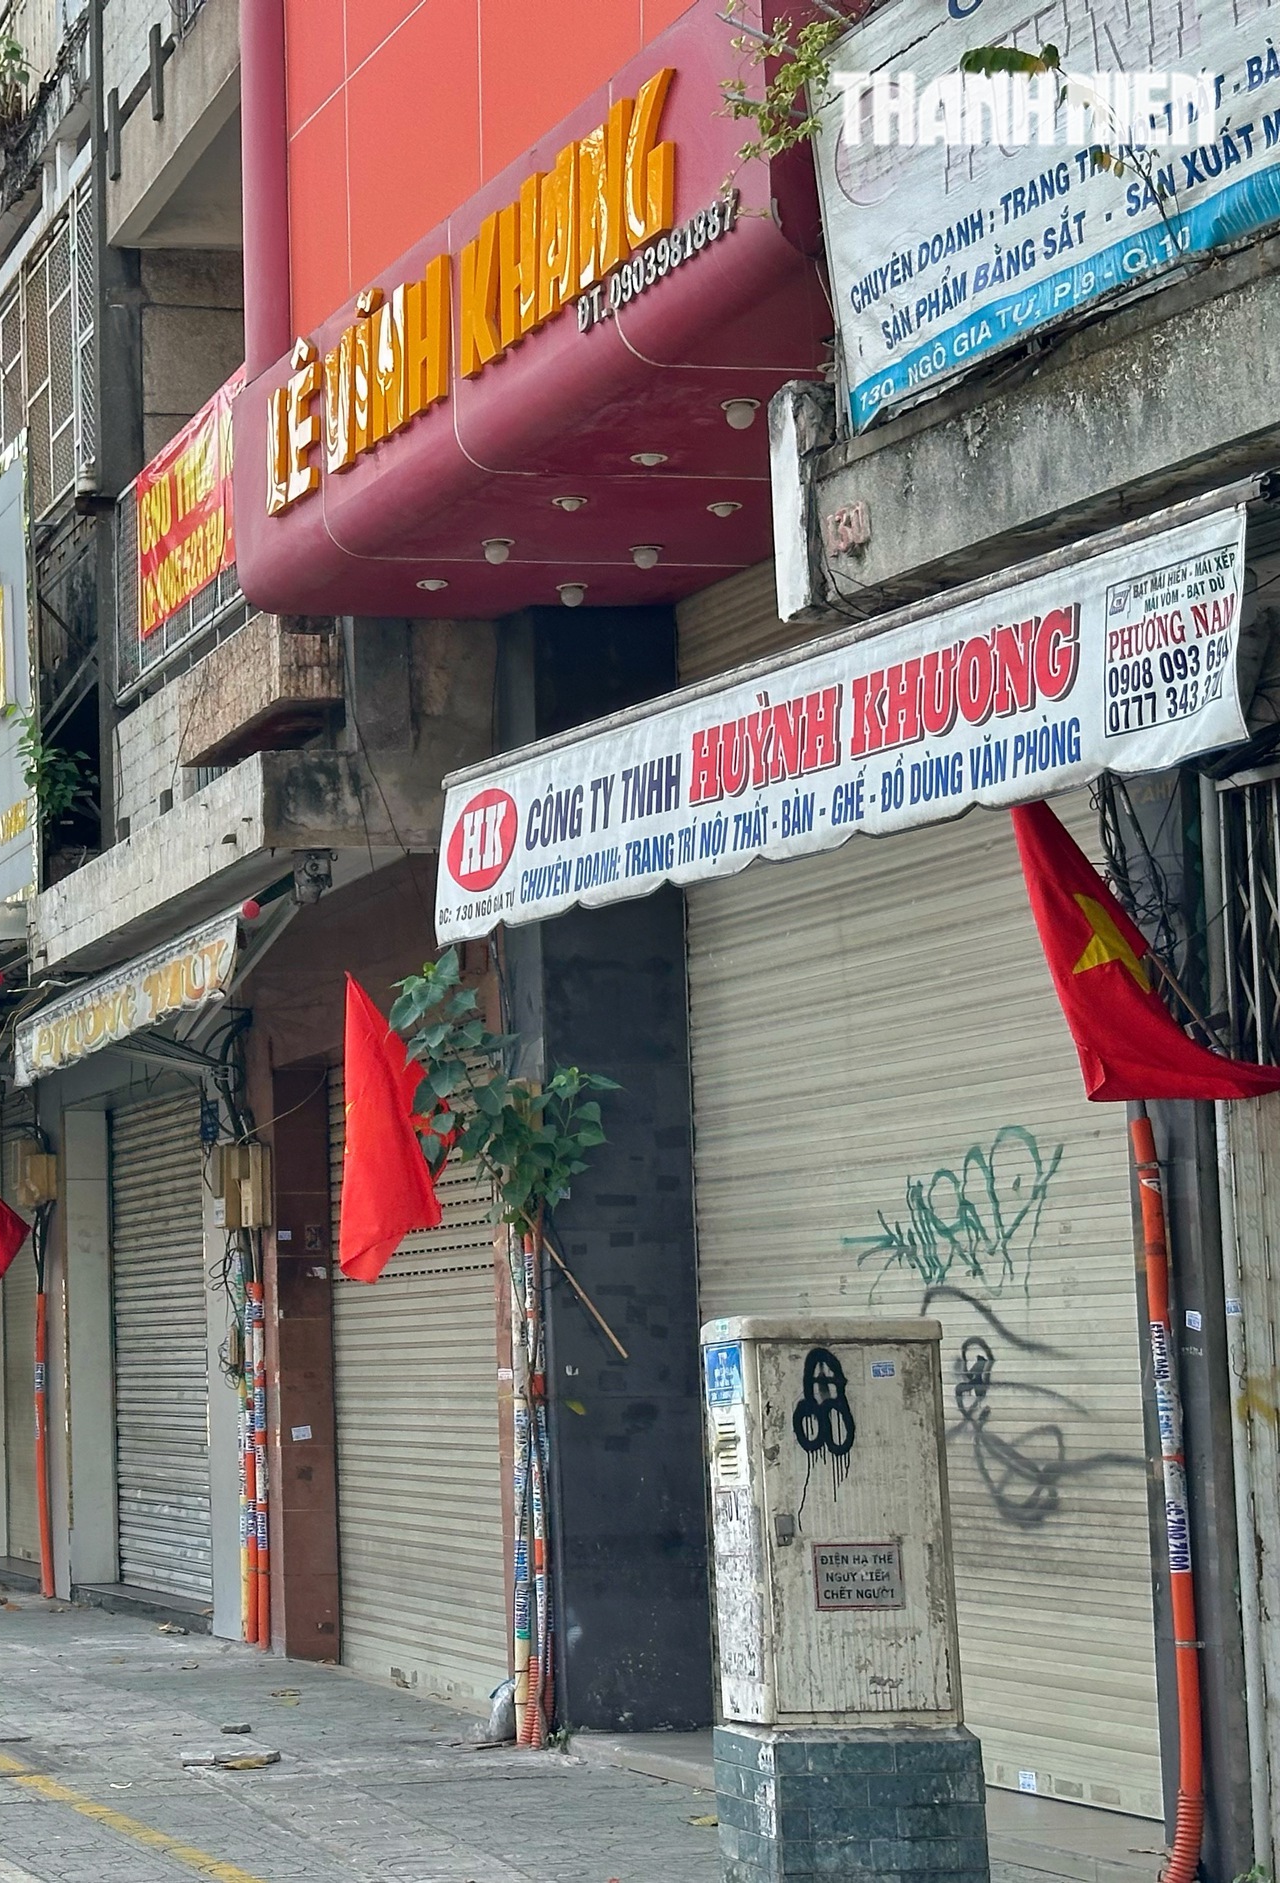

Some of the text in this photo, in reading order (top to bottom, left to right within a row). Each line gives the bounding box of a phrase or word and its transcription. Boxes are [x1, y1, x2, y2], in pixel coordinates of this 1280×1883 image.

[851, 252, 913, 314] CHUYÊN
[917, 209, 985, 272] DOANH
[1000, 162, 1070, 225] TRANG
[881, 304, 913, 350] SẢN
[915, 265, 967, 329] PHẨM
[972, 243, 1036, 294] BẰNG
[1043, 205, 1086, 261] SẮT
[1181, 116, 1254, 189] XUẤT
[266, 337, 323, 517] LÊ
[461, 67, 676, 380] KHANG
[860, 378, 895, 411] 130
[908, 342, 946, 387] NGÔ
[953, 320, 992, 358] GIA
[1133, 583, 1148, 600] BẠT
[1194, 556, 1212, 577] MÁI
[1213, 548, 1236, 572] XẾP
[1144, 572, 1226, 613] MÁI VÒM BẠT DÙ
[1108, 593, 1236, 664] PHƯƠNG NAM
[689, 603, 1080, 805] HUỲNH KHƯƠNG
[1108, 657, 1154, 698] 0908
[1160, 645, 1201, 684] 093
[1109, 691, 1157, 732] 0777
[1167, 680, 1199, 718] 343
[520, 715, 1081, 904] CHUYÊN DOANH: TRANG TRÍ NỘI THẤT BÀN GHẾ ĐỒ DÙNG VĂN PHÒNG
[525, 753, 682, 851] CÔNG TY TNHH
[459, 800, 508, 877] HK
[456, 903, 473, 921] 130
[475, 895, 492, 918] NGÔ
[820, 1551, 894, 1567] ĐIỆN HẠ THẾ
[823, 1586, 852, 1599] CHẾT
[825, 1571, 857, 1582] NGUY
